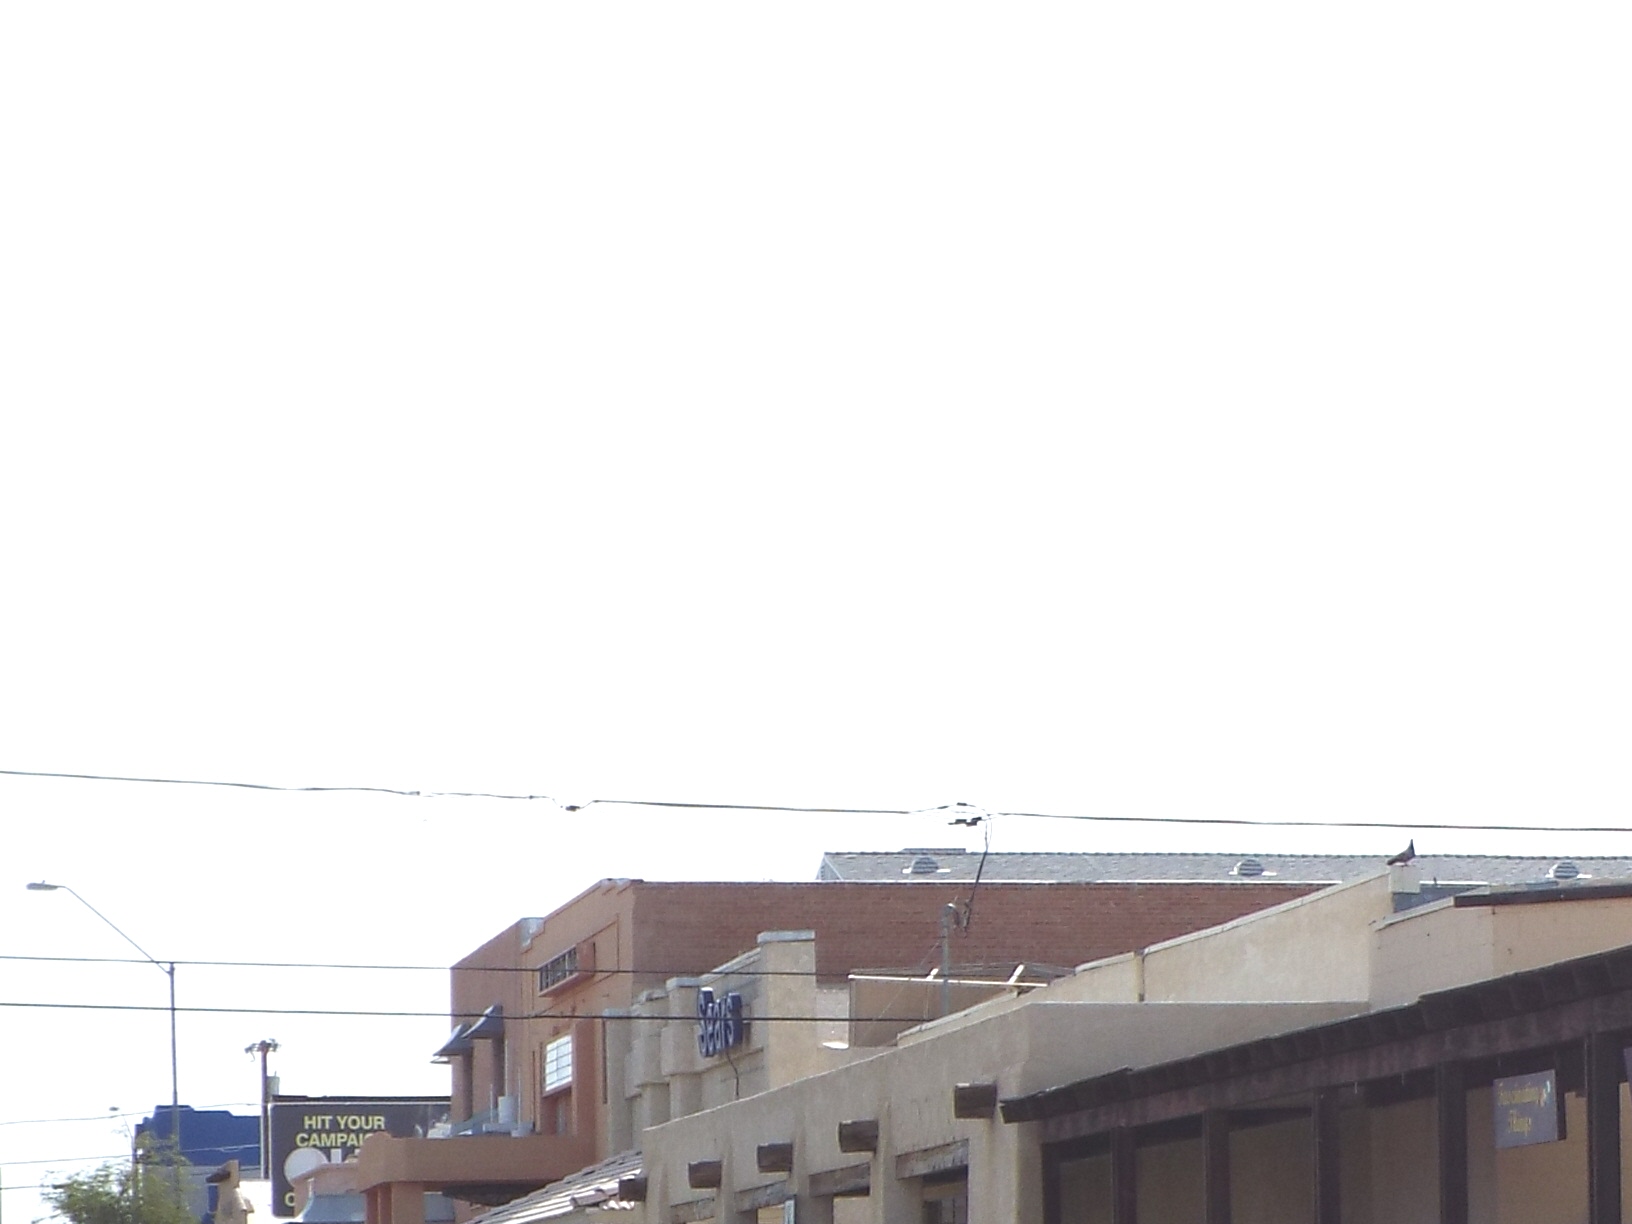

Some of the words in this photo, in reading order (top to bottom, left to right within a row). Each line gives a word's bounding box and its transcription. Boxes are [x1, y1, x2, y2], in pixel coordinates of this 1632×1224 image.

[697, 987, 741, 1057] Sears
[303, 1115, 332, 1130] HIT
[336, 1115, 385, 1130] YOUR
[295, 1132, 374, 1147] CAMPAI
